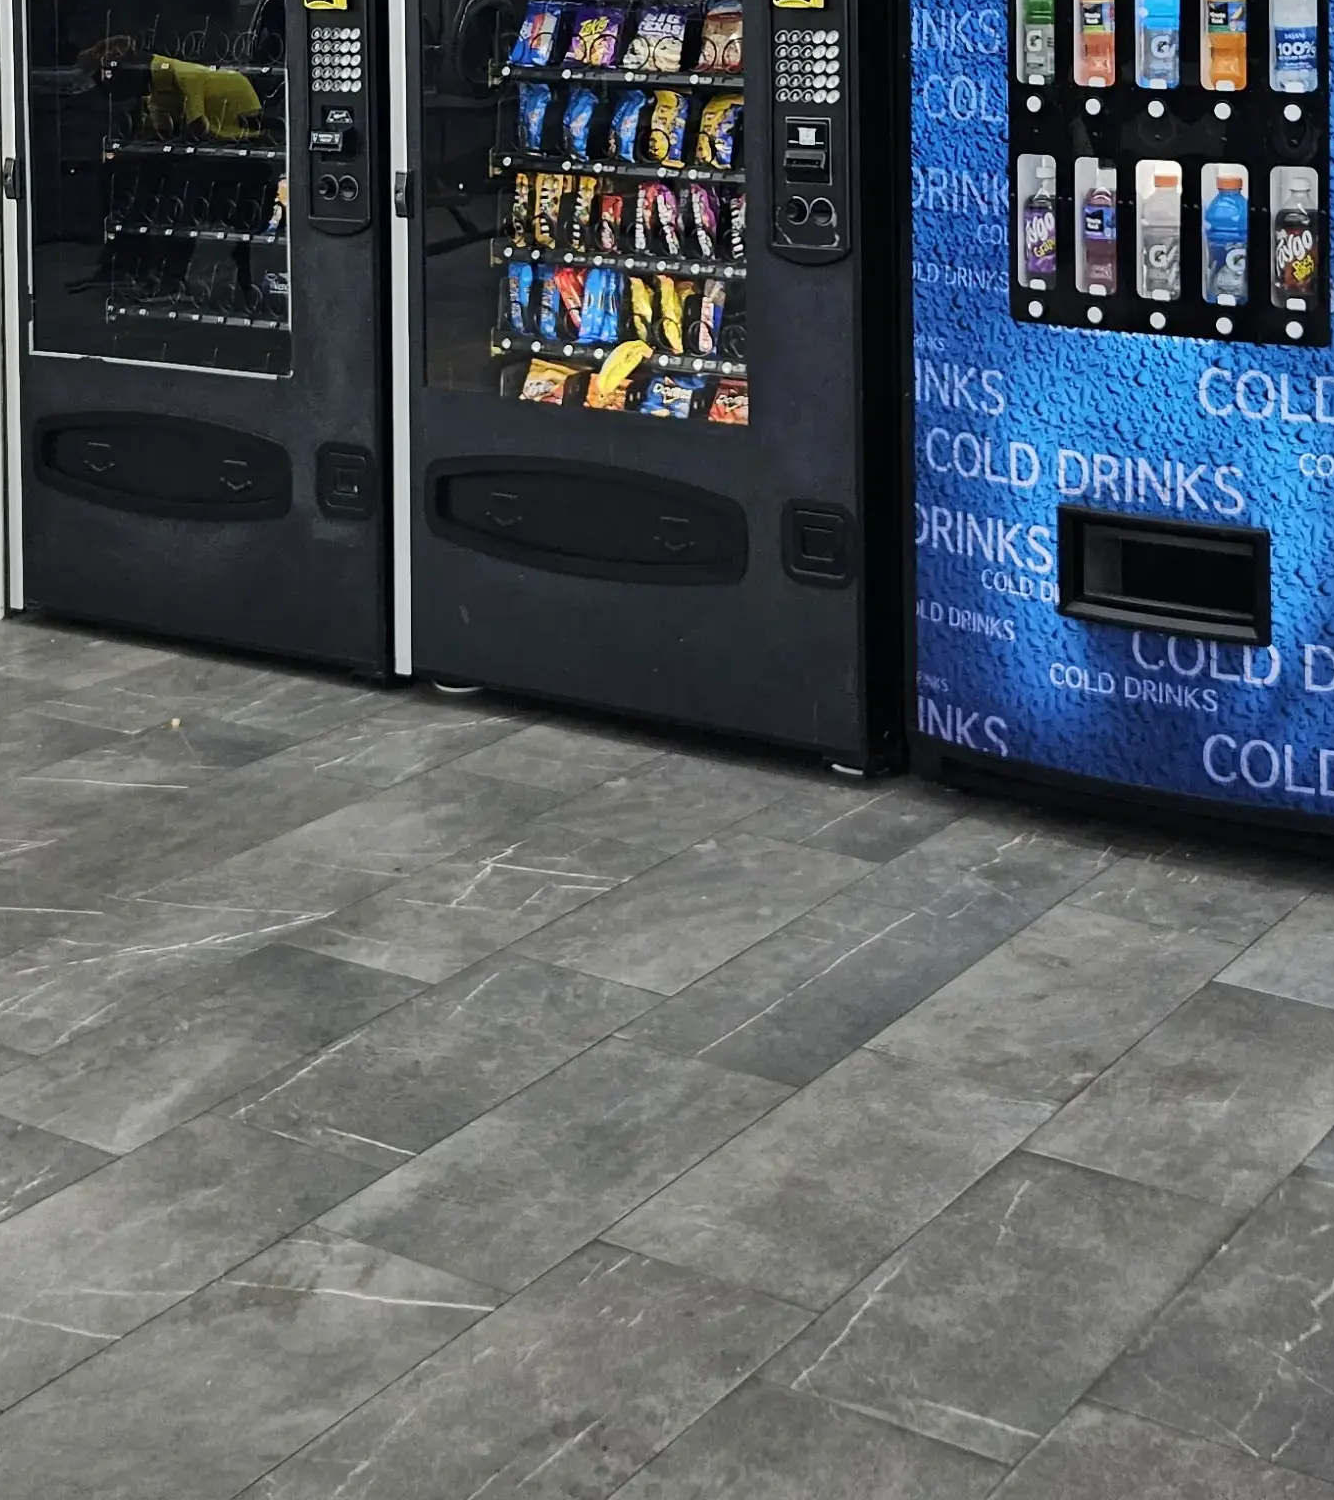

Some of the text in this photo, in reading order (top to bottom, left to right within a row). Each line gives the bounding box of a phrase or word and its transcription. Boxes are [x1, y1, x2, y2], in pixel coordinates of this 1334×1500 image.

[643, 13, 683, 24] BIG
[1025, 31, 1043, 52] G
[1150, 35, 1171, 59] G
[1148, 244, 1168, 268] G
[1225, 248, 1247, 273] G
[912, 262, 1010, 293] LD DRINKS
[915, 358, 1005, 416] INKS
[925, 427, 1244, 516] COLD DRINKS
[914, 502, 1055, 573] DRINKS
[981, 569, 1034, 598] COLD
[916, 599, 1016, 642] LD DRINKS
[1131, 630, 1281, 687] COLD
[1049, 662, 1218, 713] COLD DRINKS
[917, 695, 1008, 757] INKS
